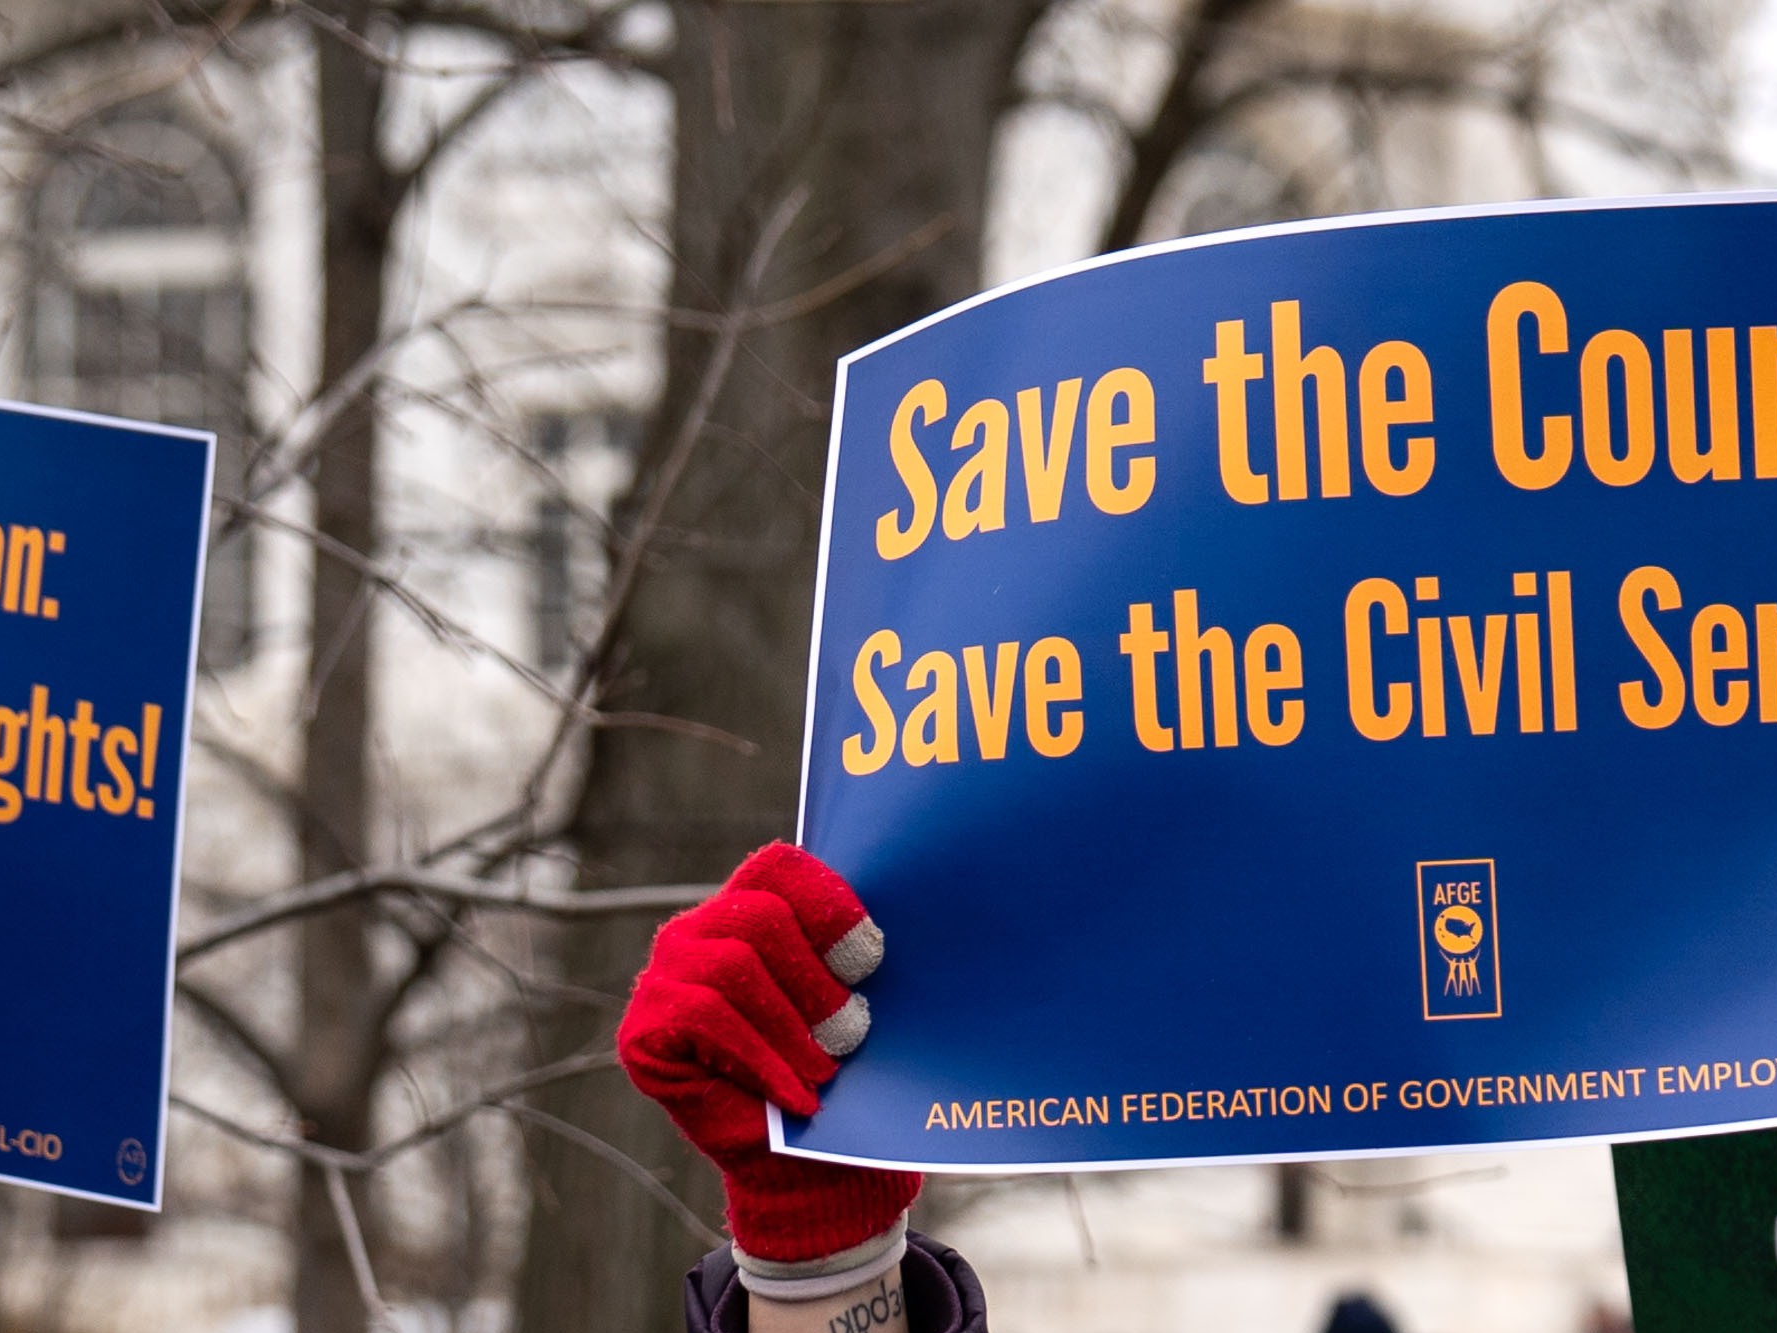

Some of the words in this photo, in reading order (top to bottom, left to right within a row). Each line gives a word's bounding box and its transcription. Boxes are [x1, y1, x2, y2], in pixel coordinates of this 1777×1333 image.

[876, 368, 1155, 560] Save
[1203, 301, 1435, 504] the
[843, 630, 1083, 775] Save
[1120, 590, 1304, 752] the
[1345, 571, 1577, 741] Civil
[1434, 882, 1481, 906] AFGE
[926, 1096, 1108, 1131] AMERICAN
[1122, 1084, 1330, 1124] FEDERATION
[1343, 1082, 1388, 1113] OF
[1399, 1068, 1646, 1110] GOVERNMENT
